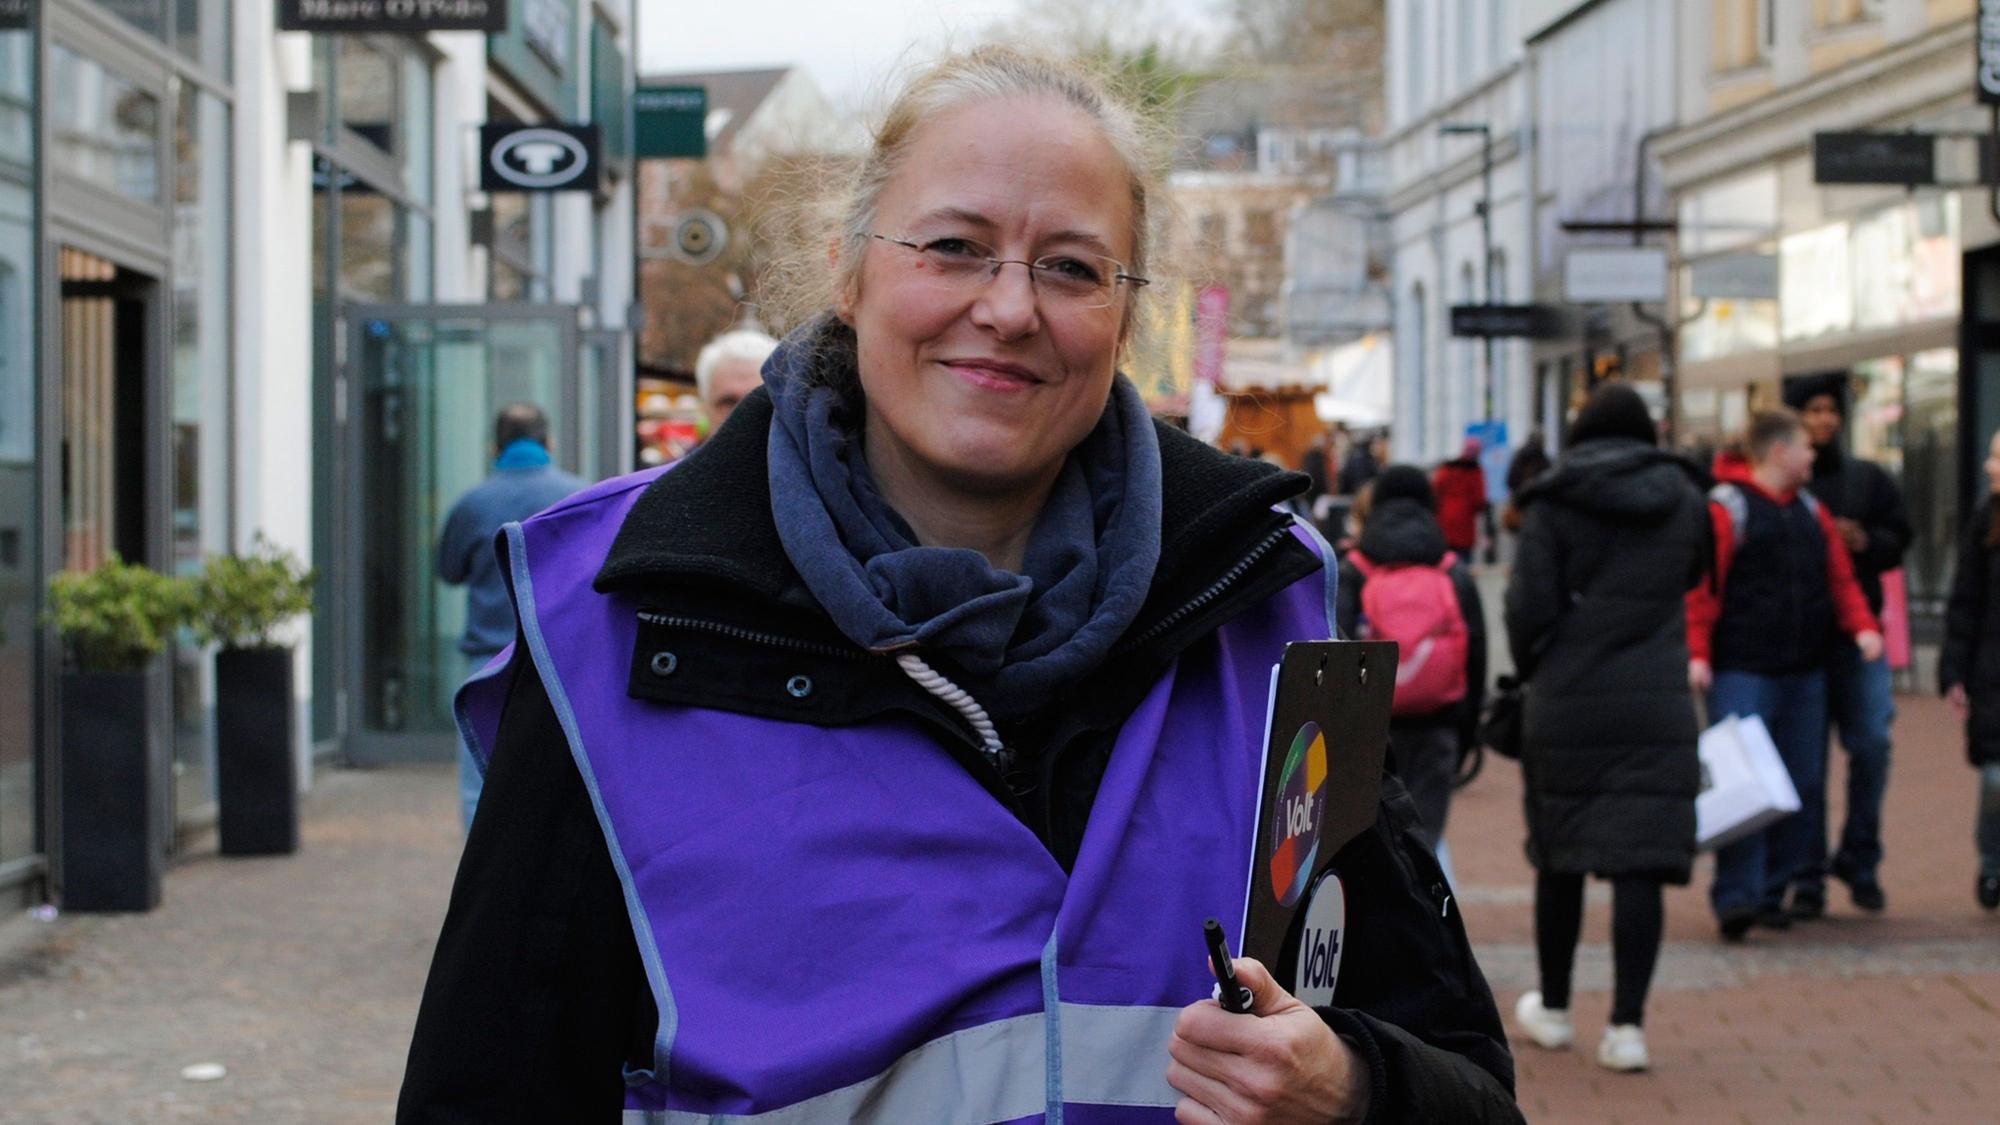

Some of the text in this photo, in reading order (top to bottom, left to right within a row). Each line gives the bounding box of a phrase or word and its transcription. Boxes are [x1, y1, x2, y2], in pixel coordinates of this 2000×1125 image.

[301, 0, 381, 18] Marc
[1286, 791, 1314, 839] Volt
[1303, 927, 1340, 990] Volt
